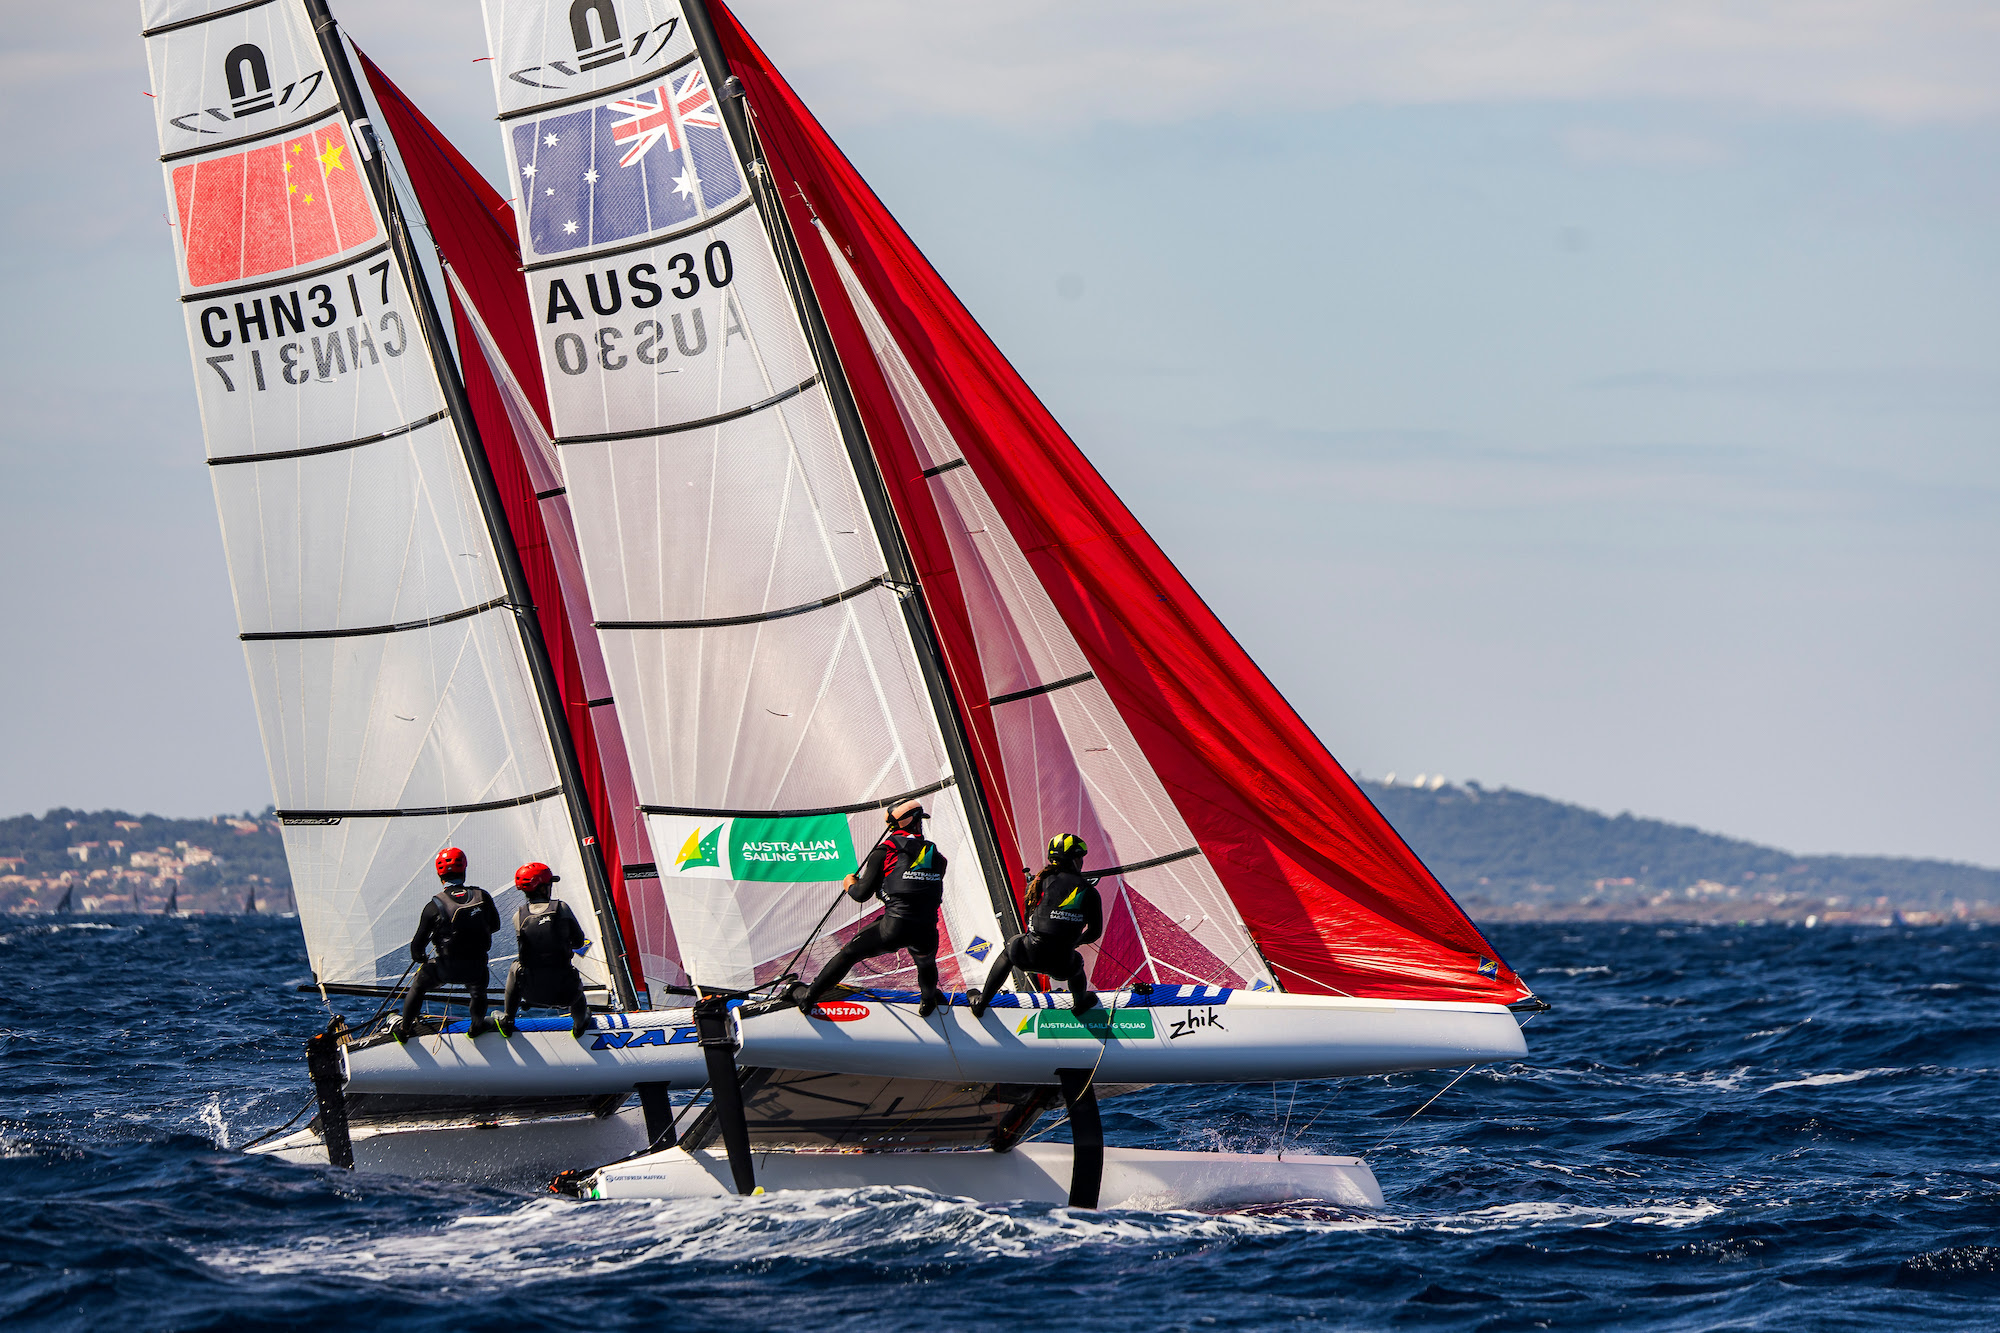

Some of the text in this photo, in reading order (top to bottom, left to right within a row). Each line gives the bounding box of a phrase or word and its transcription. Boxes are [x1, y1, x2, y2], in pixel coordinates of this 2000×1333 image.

[547, 240, 733, 324] AUS30
[200, 259, 390, 348] CHN317
[742, 840, 836, 852] AUSTRALIAN
[743, 850, 839, 862] SAILING TEAM
[810, 1007, 867, 1016] RONSTAN
[1170, 1006, 1225, 1039] zhik
